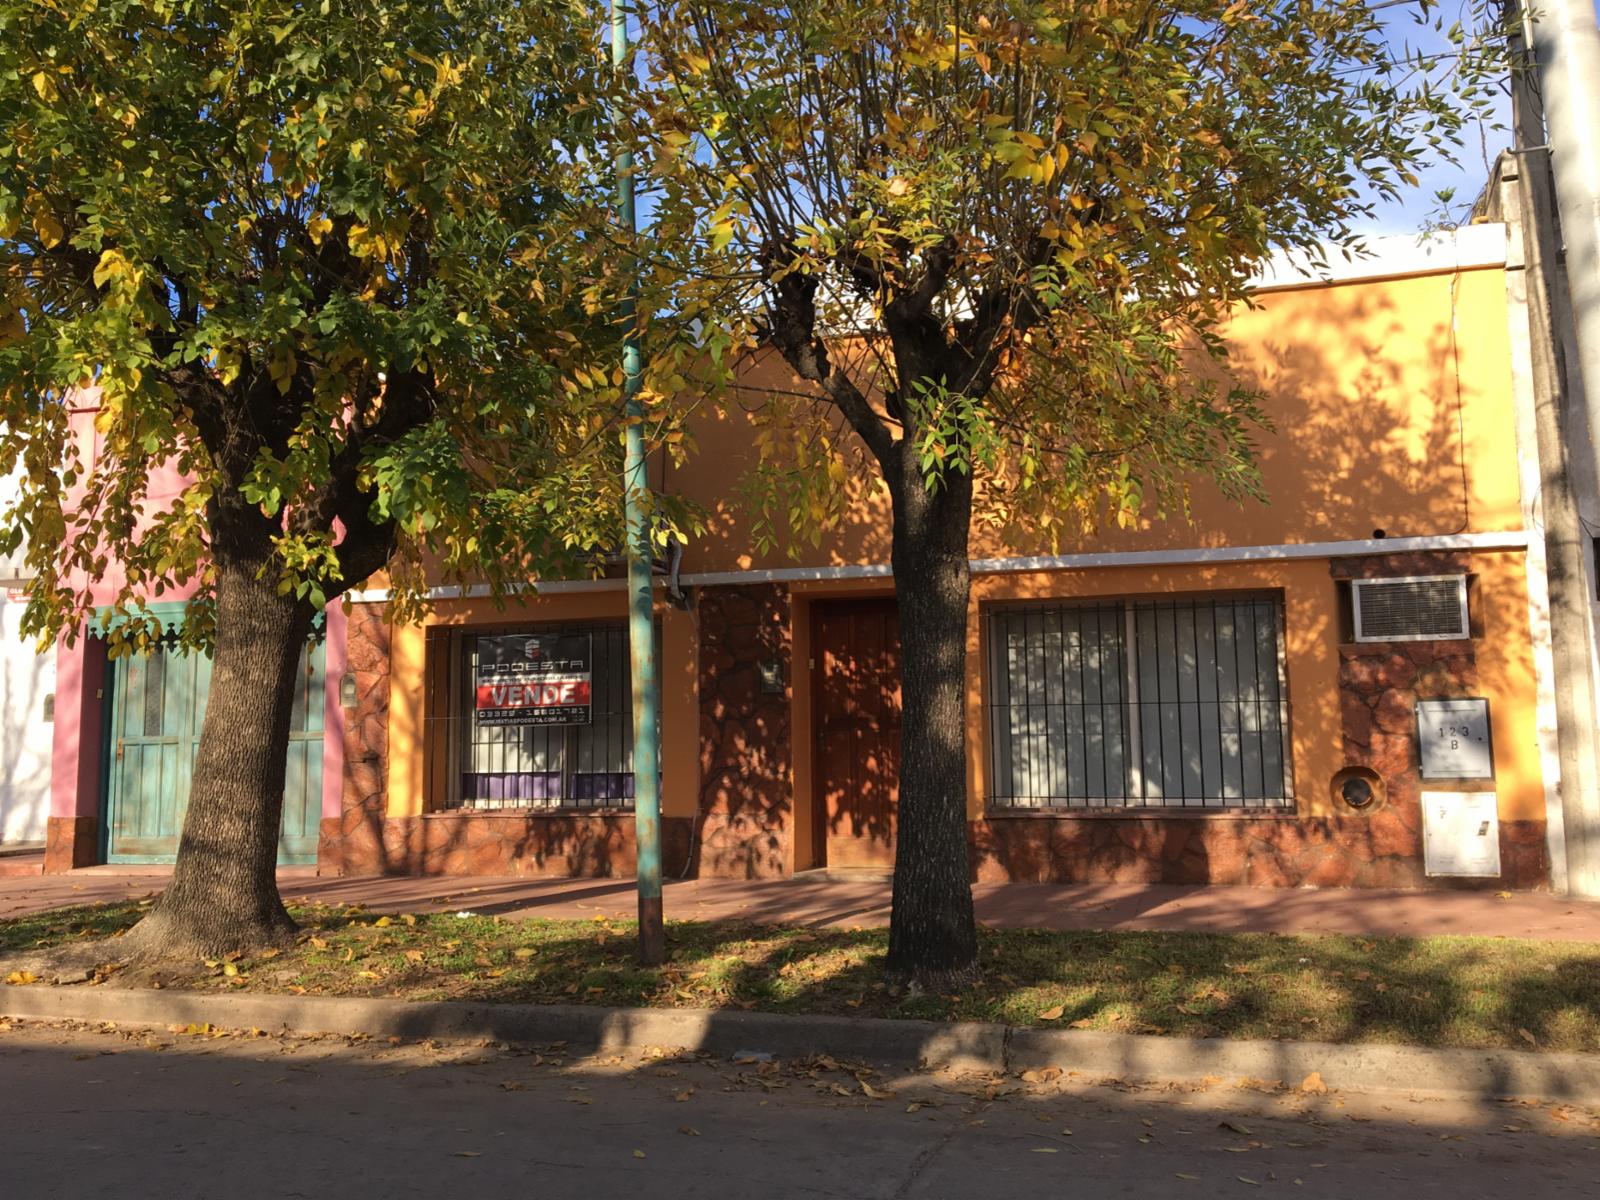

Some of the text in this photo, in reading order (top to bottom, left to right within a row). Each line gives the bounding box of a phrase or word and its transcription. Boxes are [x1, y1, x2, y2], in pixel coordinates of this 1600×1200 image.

[482, 660, 584, 673] PODESTA
[491, 684, 576, 706] VENDE
[1451, 740, 1458, 750] B
